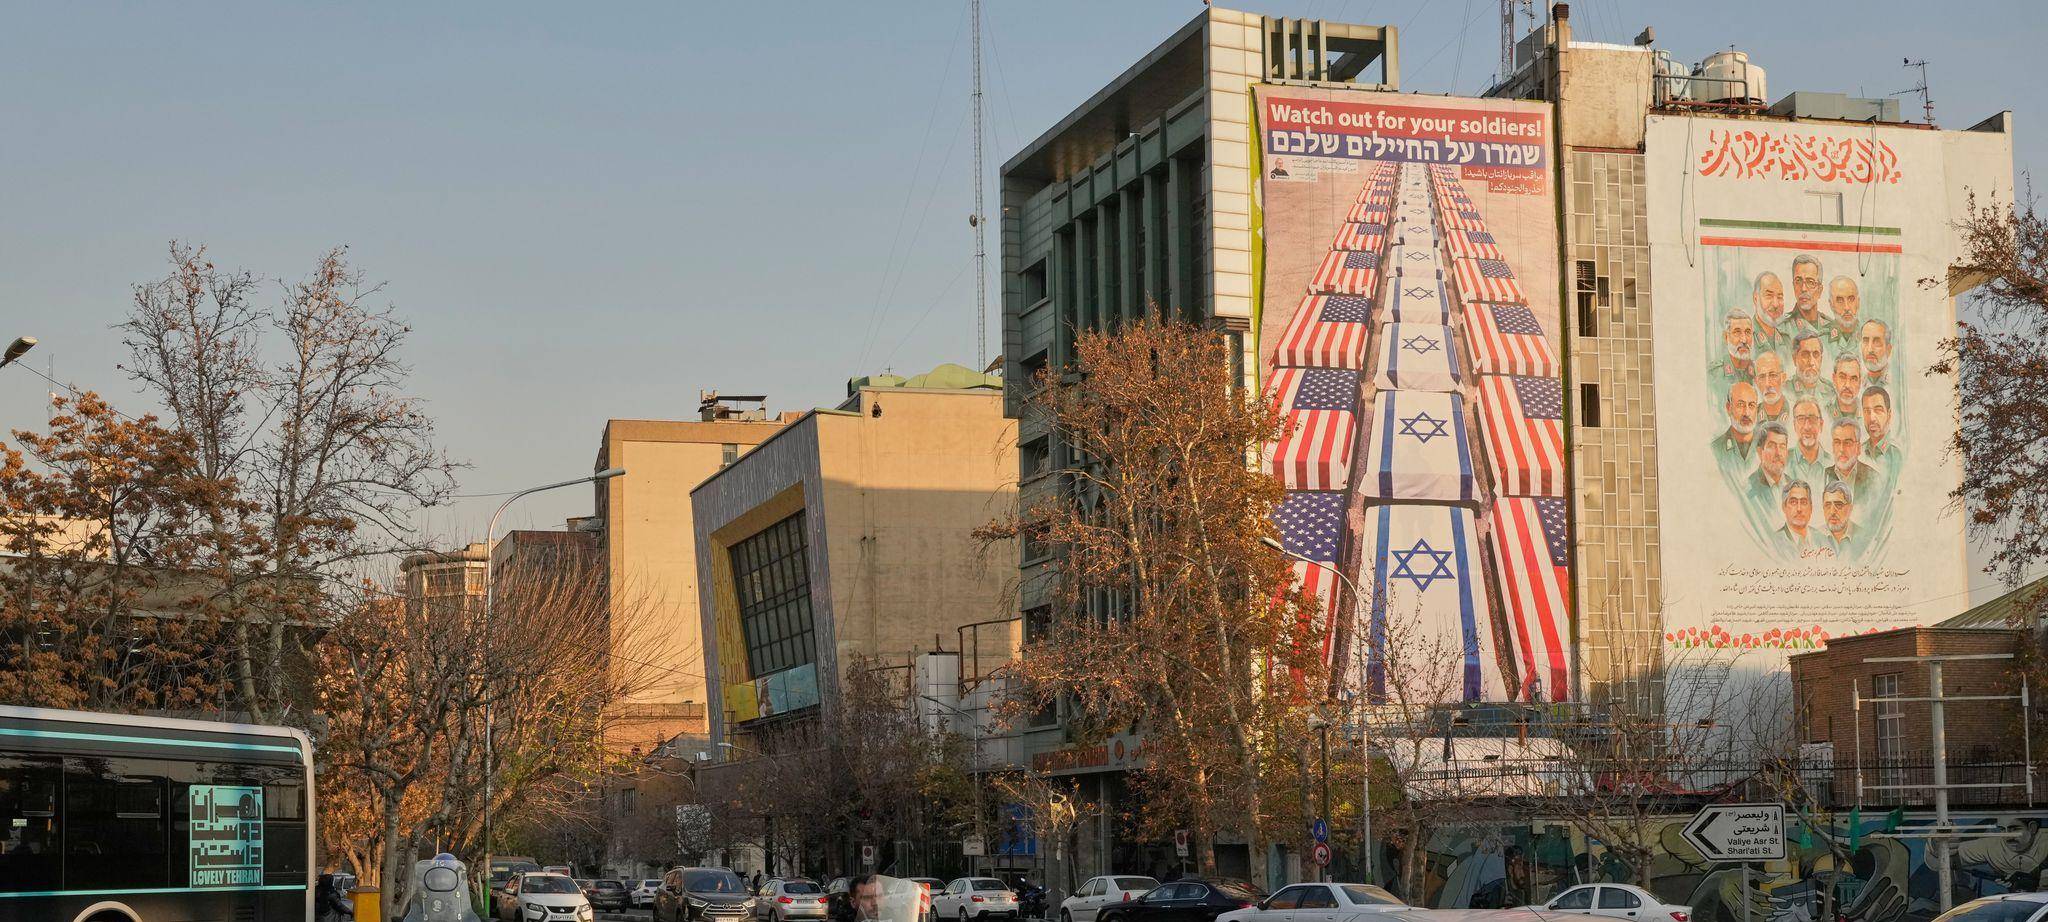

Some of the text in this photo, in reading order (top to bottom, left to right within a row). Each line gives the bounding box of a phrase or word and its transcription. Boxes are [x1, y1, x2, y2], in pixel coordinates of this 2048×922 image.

[1270, 104, 1542, 137] Watch out for your soldiers!
[1271, 126, 1541, 165] שמרו על החיילים שלכם
[1522, 170, 1544, 182] مراقب
[1734, 811, 1770, 822] ولیعصر
[1733, 824, 1770, 835] شریعتی
[1727, 838, 1751, 846] Valiye
[1769, 837, 1780, 845] St.
[1727, 846, 1773, 855] Shari'ati St.
[193, 869, 261, 885] LOVELY TEHRAN
